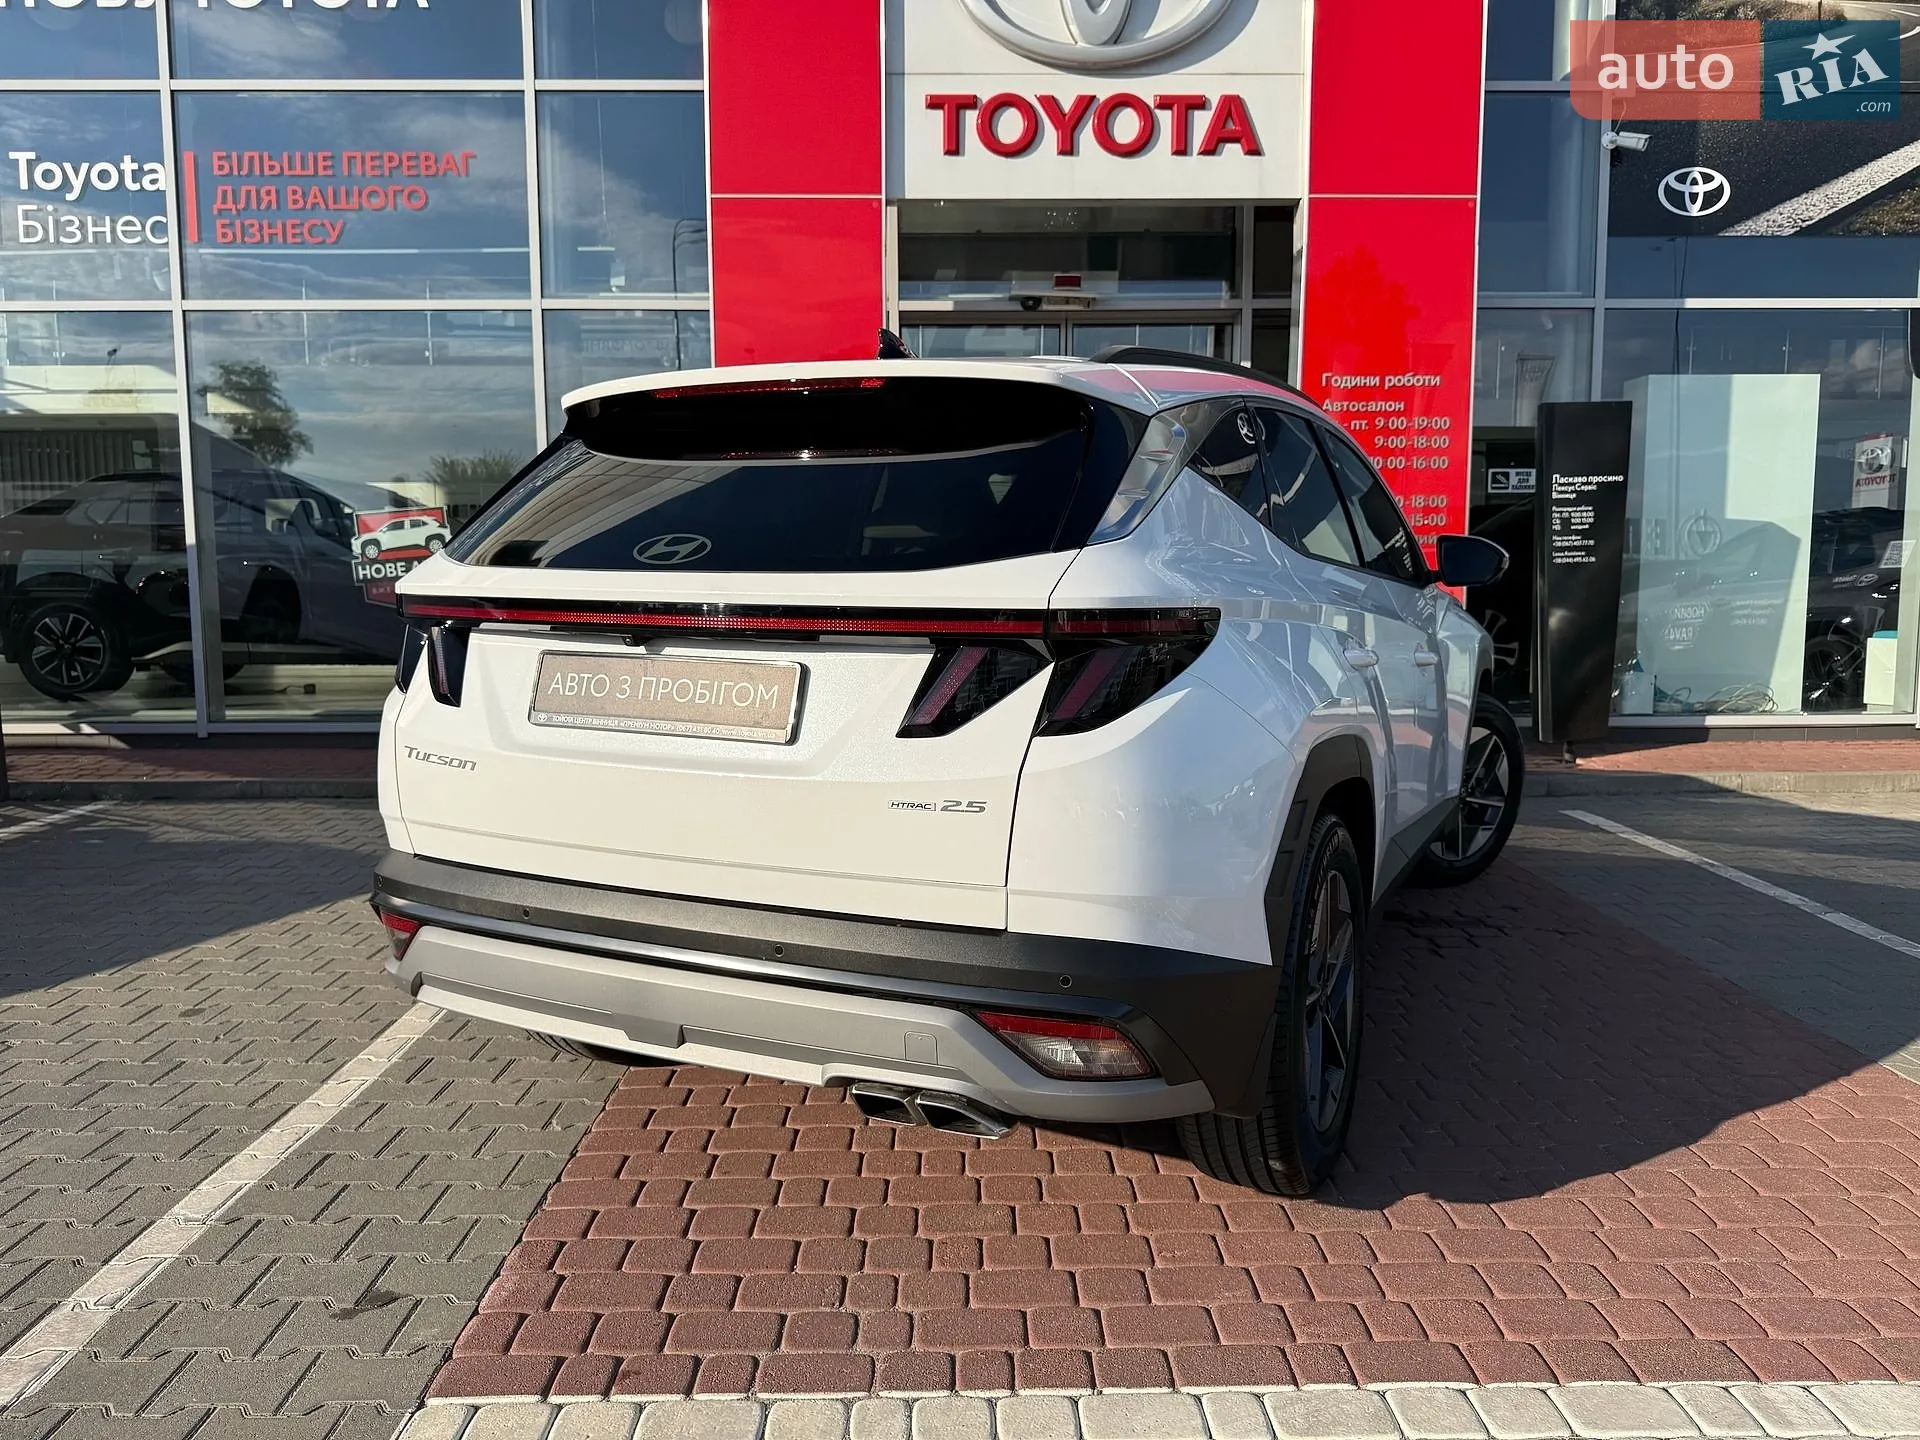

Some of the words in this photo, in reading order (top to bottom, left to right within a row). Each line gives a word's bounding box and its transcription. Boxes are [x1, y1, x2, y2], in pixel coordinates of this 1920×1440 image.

[925, 92, 1262, 158] TOYOTA
[9, 151, 167, 201] Toyota
[212, 151, 333, 176] БІЛЬШЕ
[342, 151, 476, 177] ПЕРЕВАГ
[213, 185, 279, 215] ДЛЯ
[286, 185, 428, 211] ВАШОГО
[17, 204, 168, 244] Бізнес
[216, 219, 344, 244] БІЗНЕСУ
[1321, 372, 1380, 388] Години
[1385, 371, 1441, 389] роботи
[1322, 399, 1405, 412] Автосалон
[1588, 475, 1624, 484] просимо
[1411, 513, 1447, 526] 15:00
[548, 673, 610, 698] АВТО
[638, 677, 779, 709] ПРОБІГОМ
[890, 801, 932, 810] HTRAC
